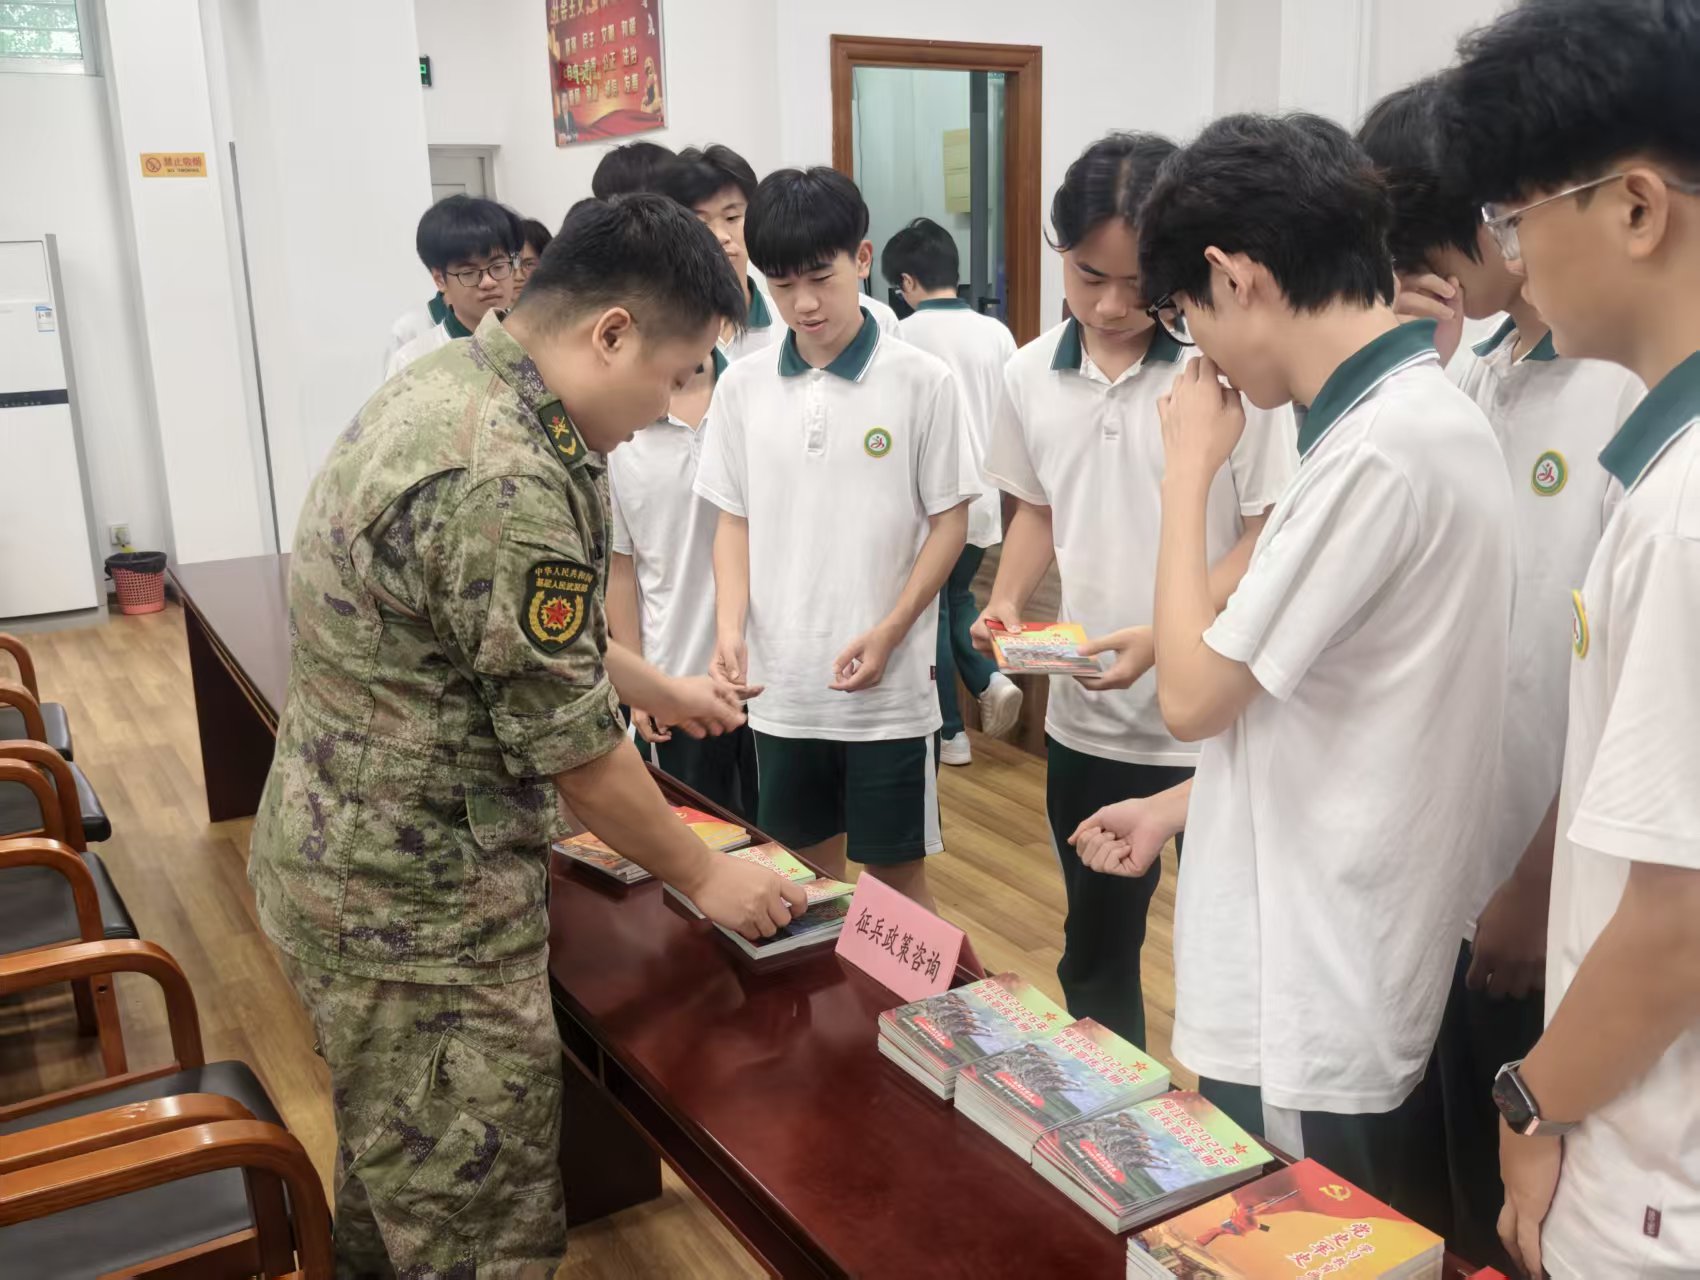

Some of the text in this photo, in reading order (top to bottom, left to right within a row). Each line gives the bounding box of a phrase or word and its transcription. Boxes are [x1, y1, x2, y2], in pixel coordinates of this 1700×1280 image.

[855, 906, 941, 984] 征兵政策咨询
